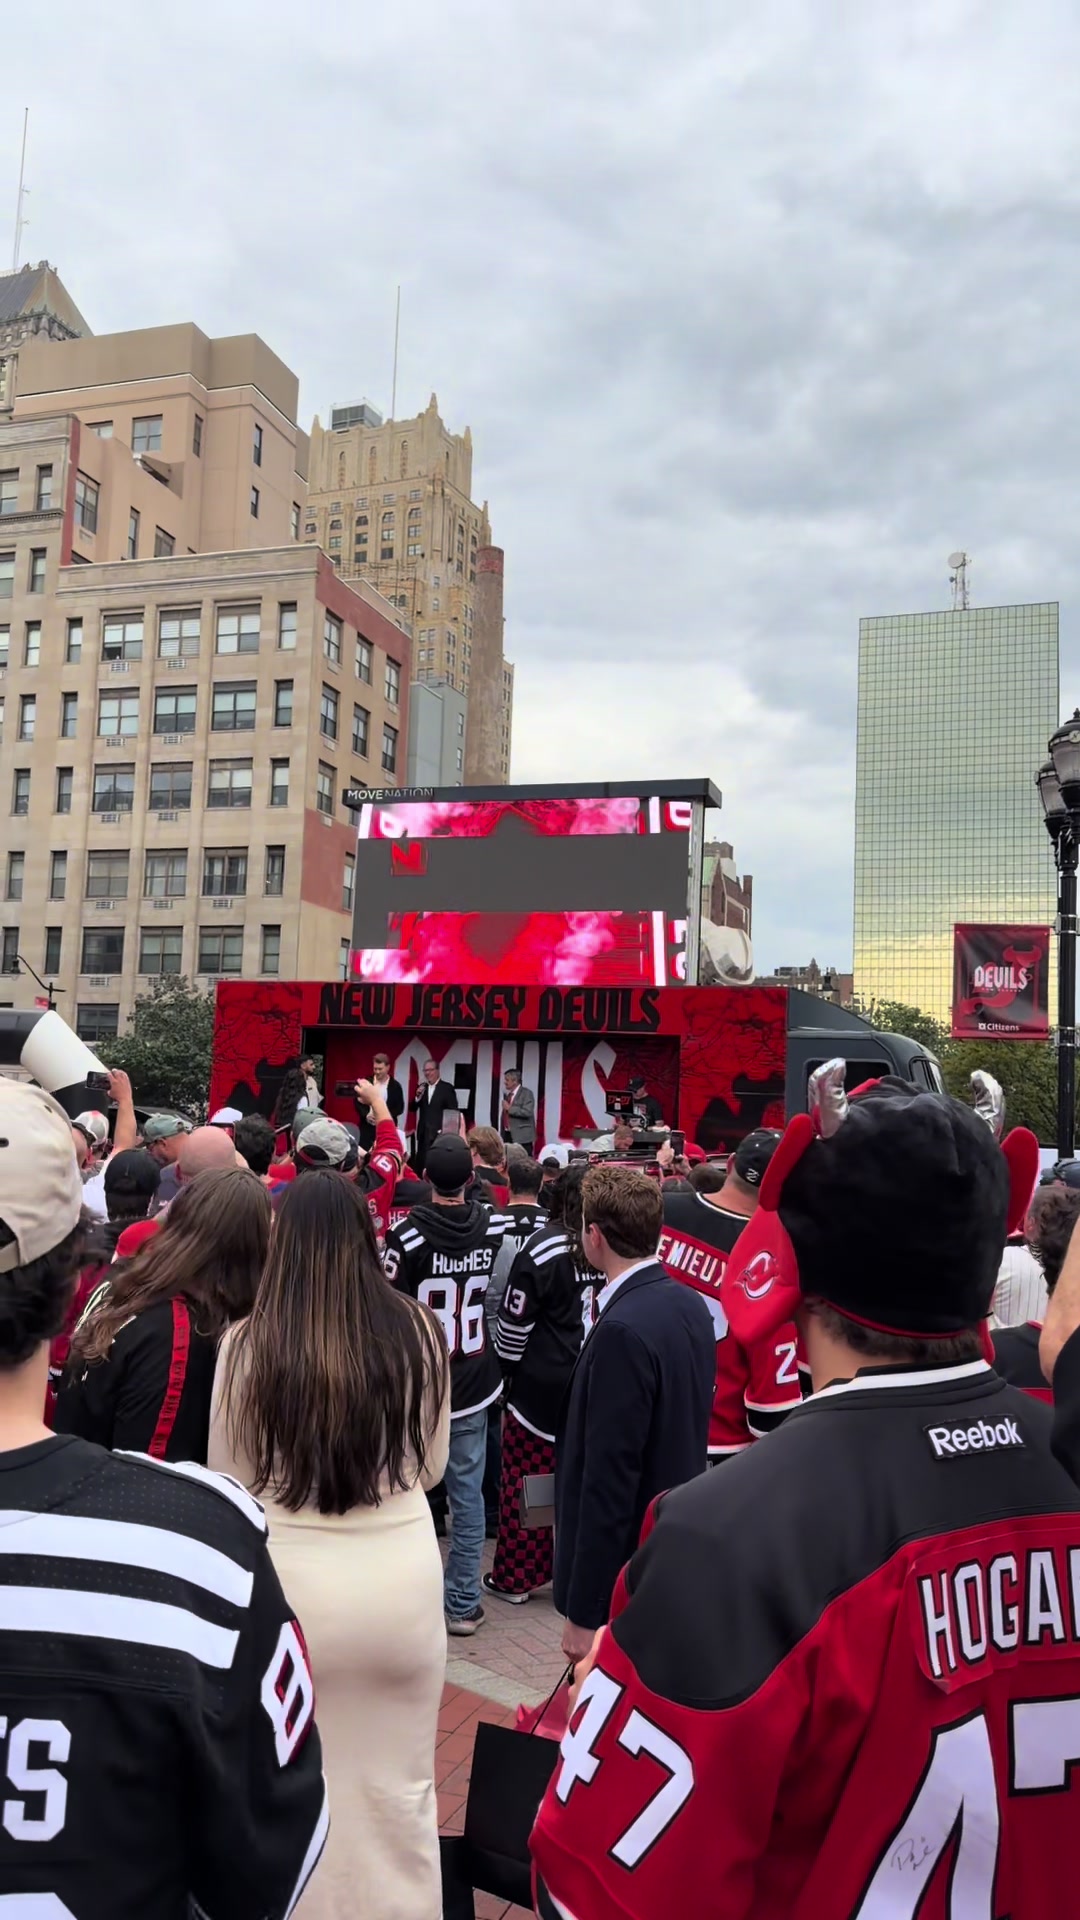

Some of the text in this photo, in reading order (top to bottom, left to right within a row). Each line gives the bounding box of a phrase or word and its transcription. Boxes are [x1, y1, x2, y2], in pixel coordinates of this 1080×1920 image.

[974, 965, 1029, 990] DEVILS
[317, 983, 661, 1033] NEW JERSEY DEVILS
[986, 1022, 1020, 1031] Citizens
[432, 1248, 493, 1275] HUGHES
[504, 1284, 527, 1316] 13
[928, 1417, 1024, 1456] Reebok
[555, 1663, 696, 1872] 47
